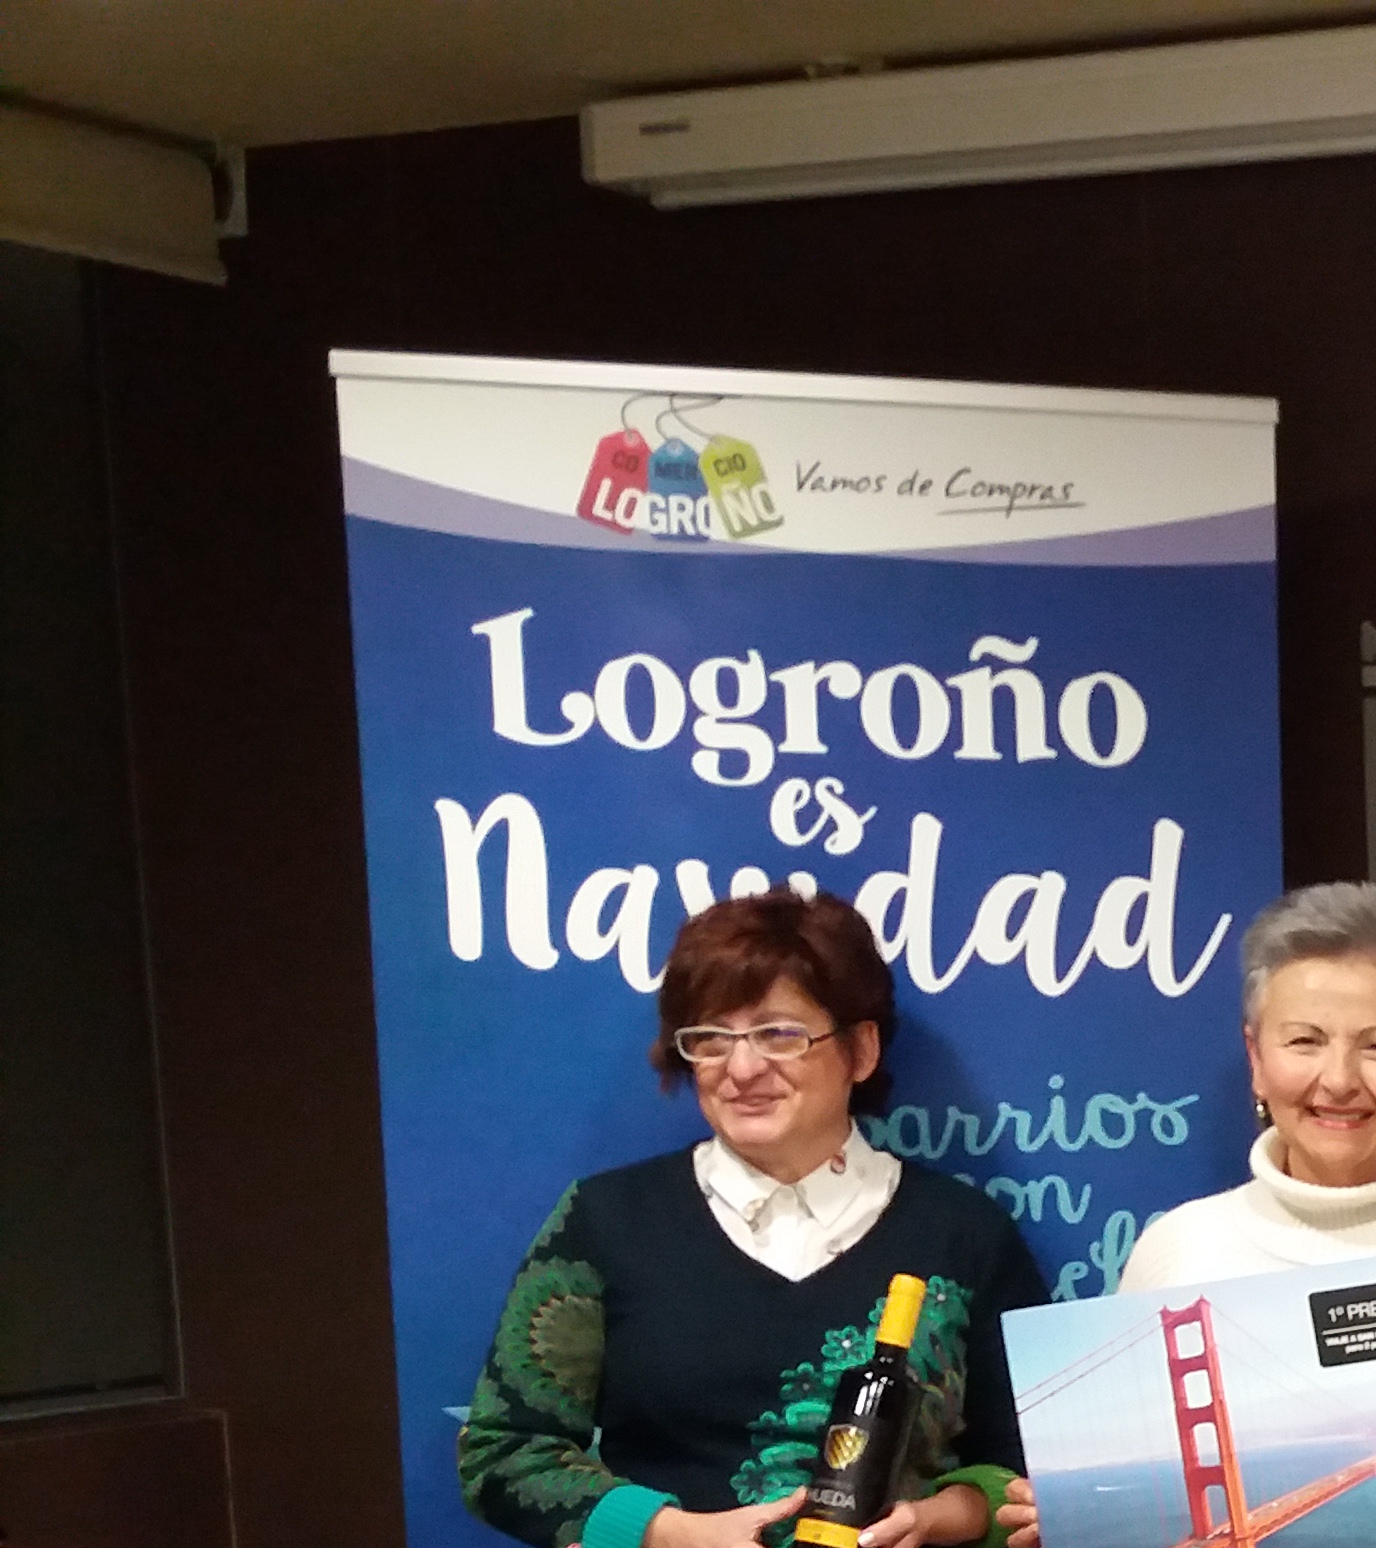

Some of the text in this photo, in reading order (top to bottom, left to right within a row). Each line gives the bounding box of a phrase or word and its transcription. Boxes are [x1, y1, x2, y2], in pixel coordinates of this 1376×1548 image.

[796, 460, 1073, 519] Vamos de Compras
[471, 607, 1149, 787] Logroño
[768, 775, 878, 856] es
[432, 792, 1234, 998] Nadad
[856, 1074, 1200, 1159] arrios
[953, 1173, 1092, 1224] on
